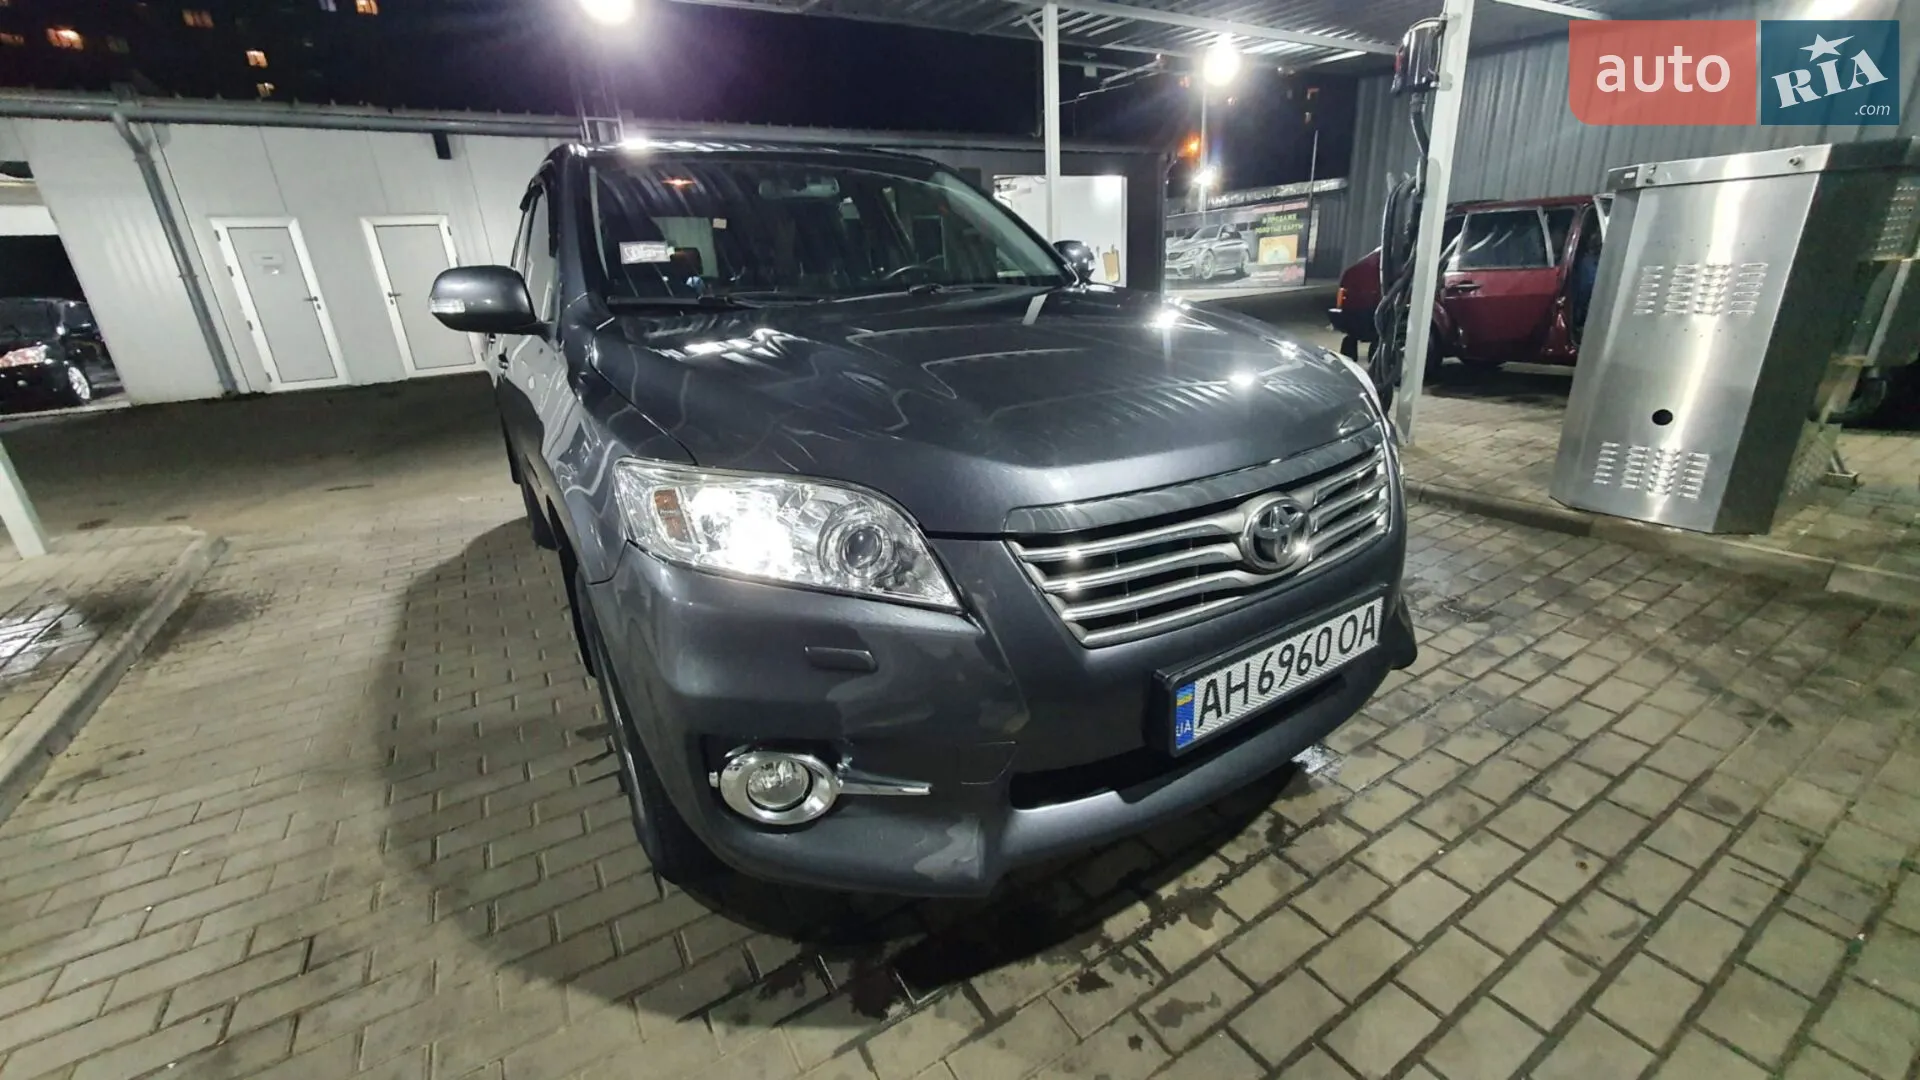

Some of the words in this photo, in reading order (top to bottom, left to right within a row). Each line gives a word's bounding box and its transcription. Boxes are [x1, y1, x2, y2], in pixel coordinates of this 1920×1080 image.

[1198, 663, 1250, 728] AH
[1257, 626, 1332, 696] 6960
[1338, 604, 1376, 654] OA
[1176, 719, 1192, 737] UA
